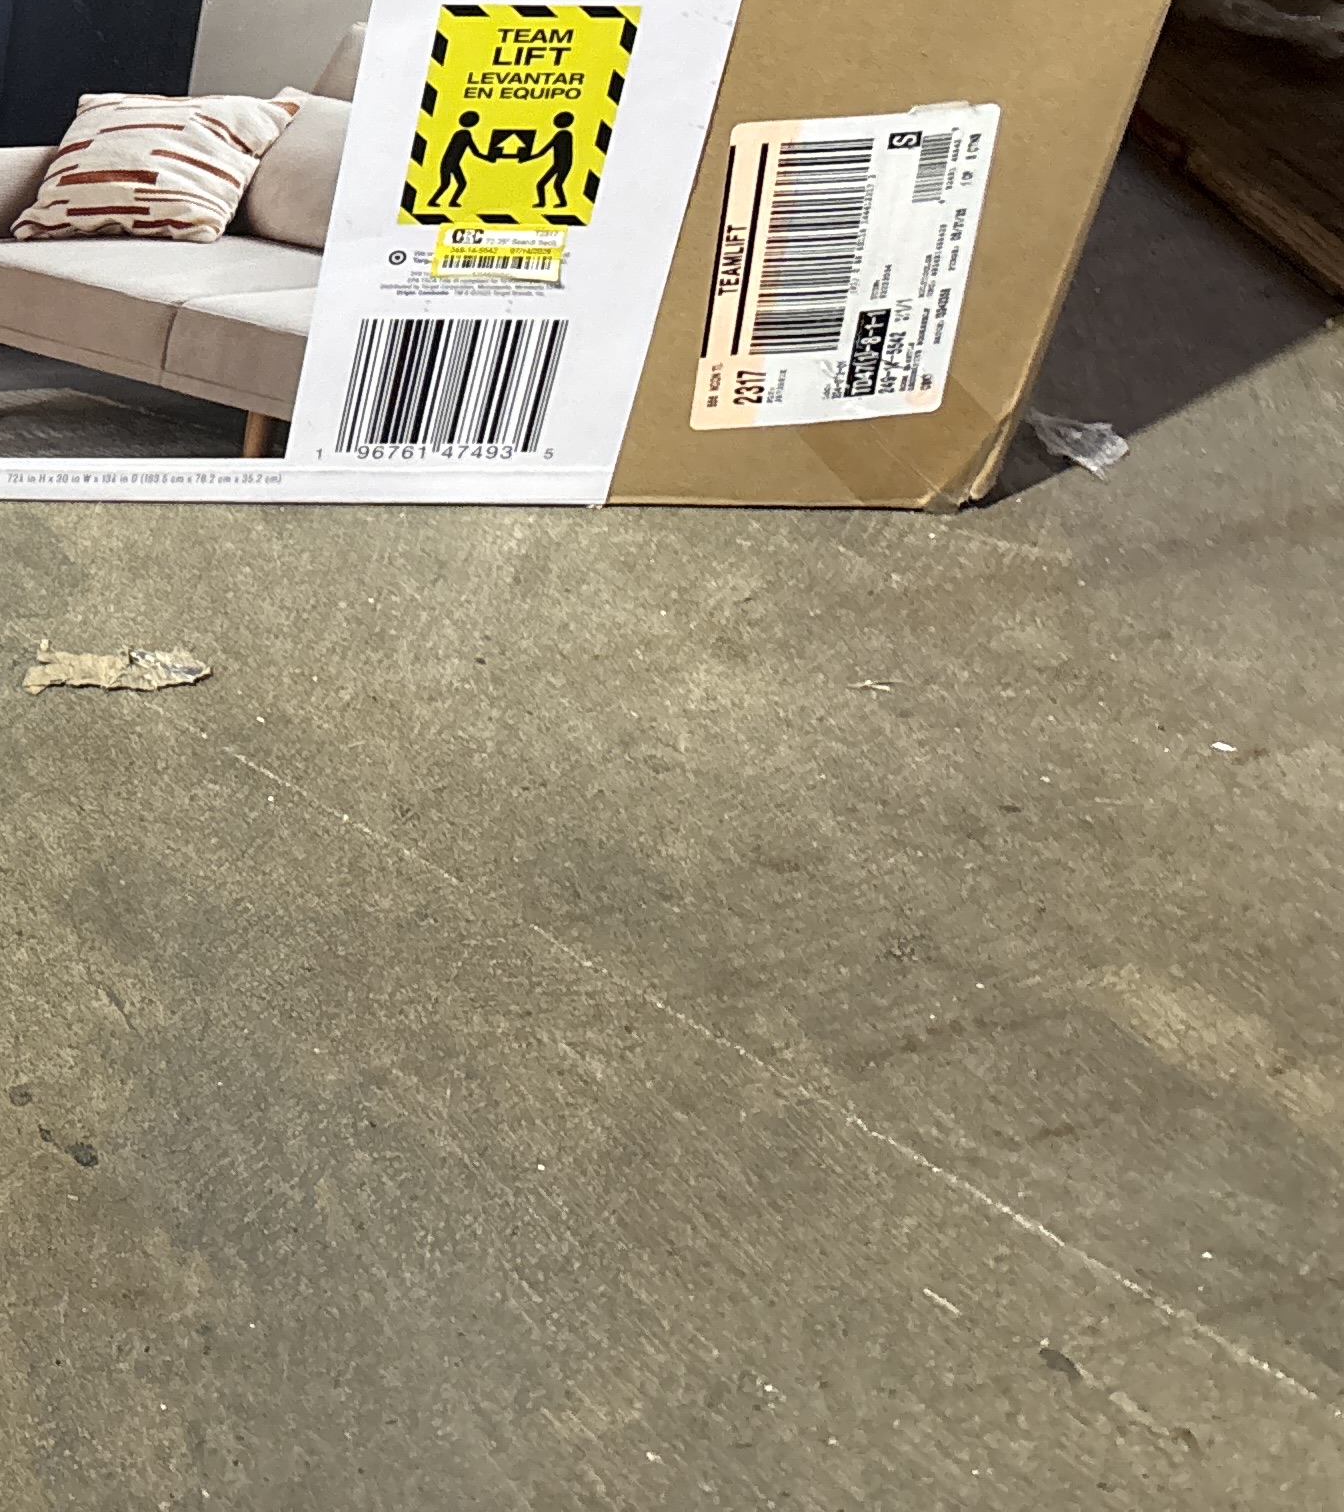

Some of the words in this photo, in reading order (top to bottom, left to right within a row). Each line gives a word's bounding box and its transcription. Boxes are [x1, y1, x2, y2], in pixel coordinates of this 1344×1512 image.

[497, 28, 575, 44] TEAM
[492, 47, 572, 66] LIFT
[466, 71, 585, 85] LEVANTAR
[463, 87, 492, 99] EN
[499, 87, 582, 100] EQUIPO
[891, 134, 918, 147] S
[718, 224, 748, 296] TEAMLIFT
[733, 370, 767, 405] 2317
[315, 448, 324, 459] 1
[356, 445, 426, 459] 96761
[441, 445, 514, 459] 47493
[543, 448, 555, 459] 5
